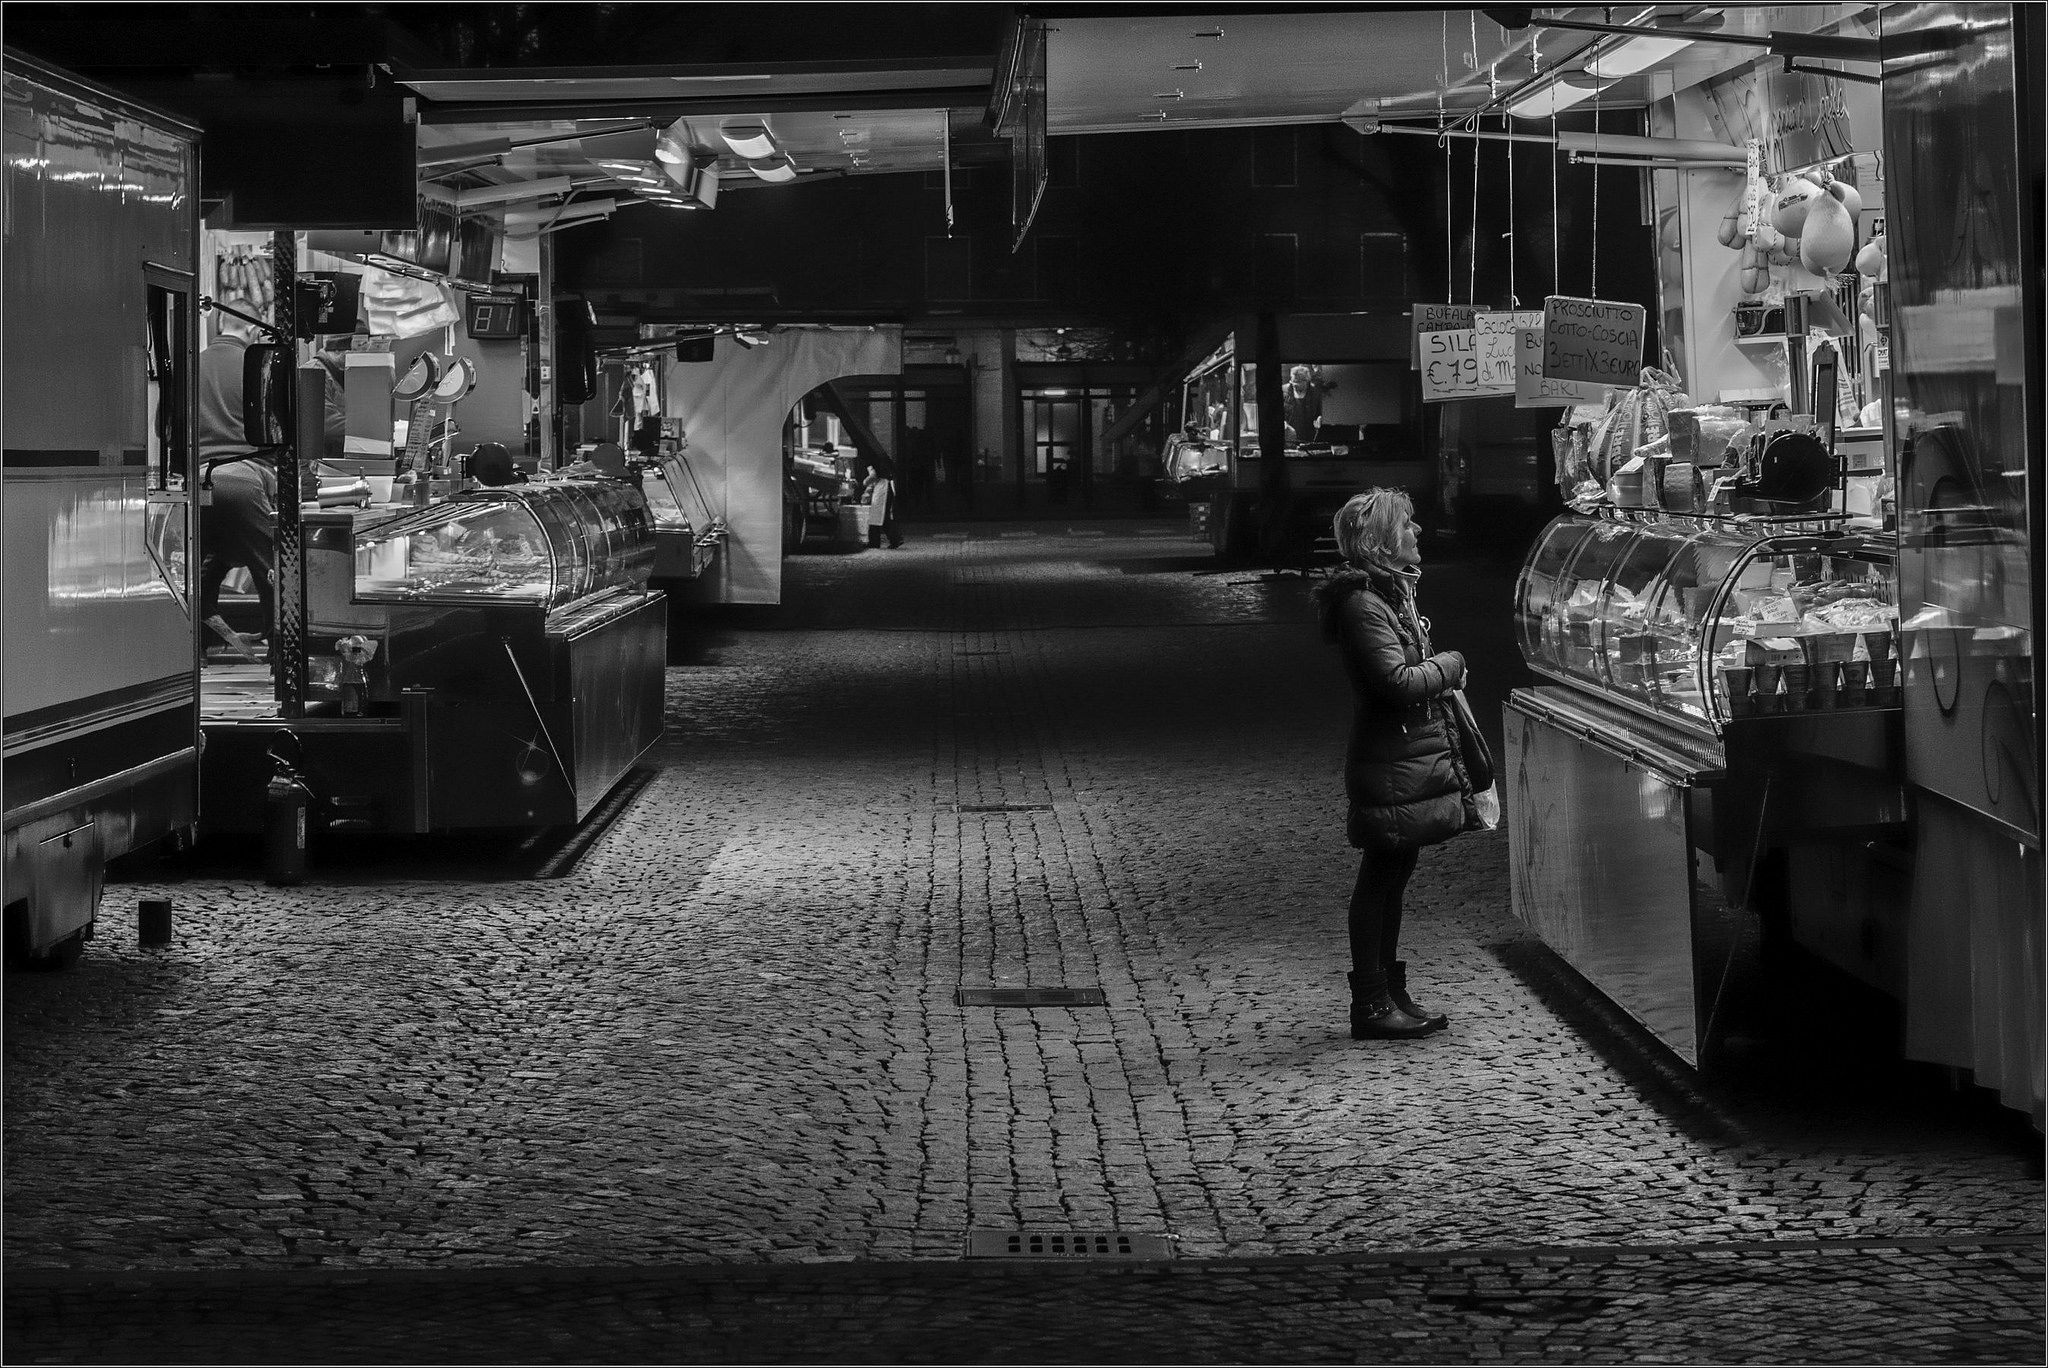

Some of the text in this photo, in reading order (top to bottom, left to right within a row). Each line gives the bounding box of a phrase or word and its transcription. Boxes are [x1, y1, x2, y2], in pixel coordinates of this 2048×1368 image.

[474, 306, 513, 332] 81
[1426, 307, 1475, 320] BUFALA
[1551, 299, 1632, 321] PROSCIUTTO
